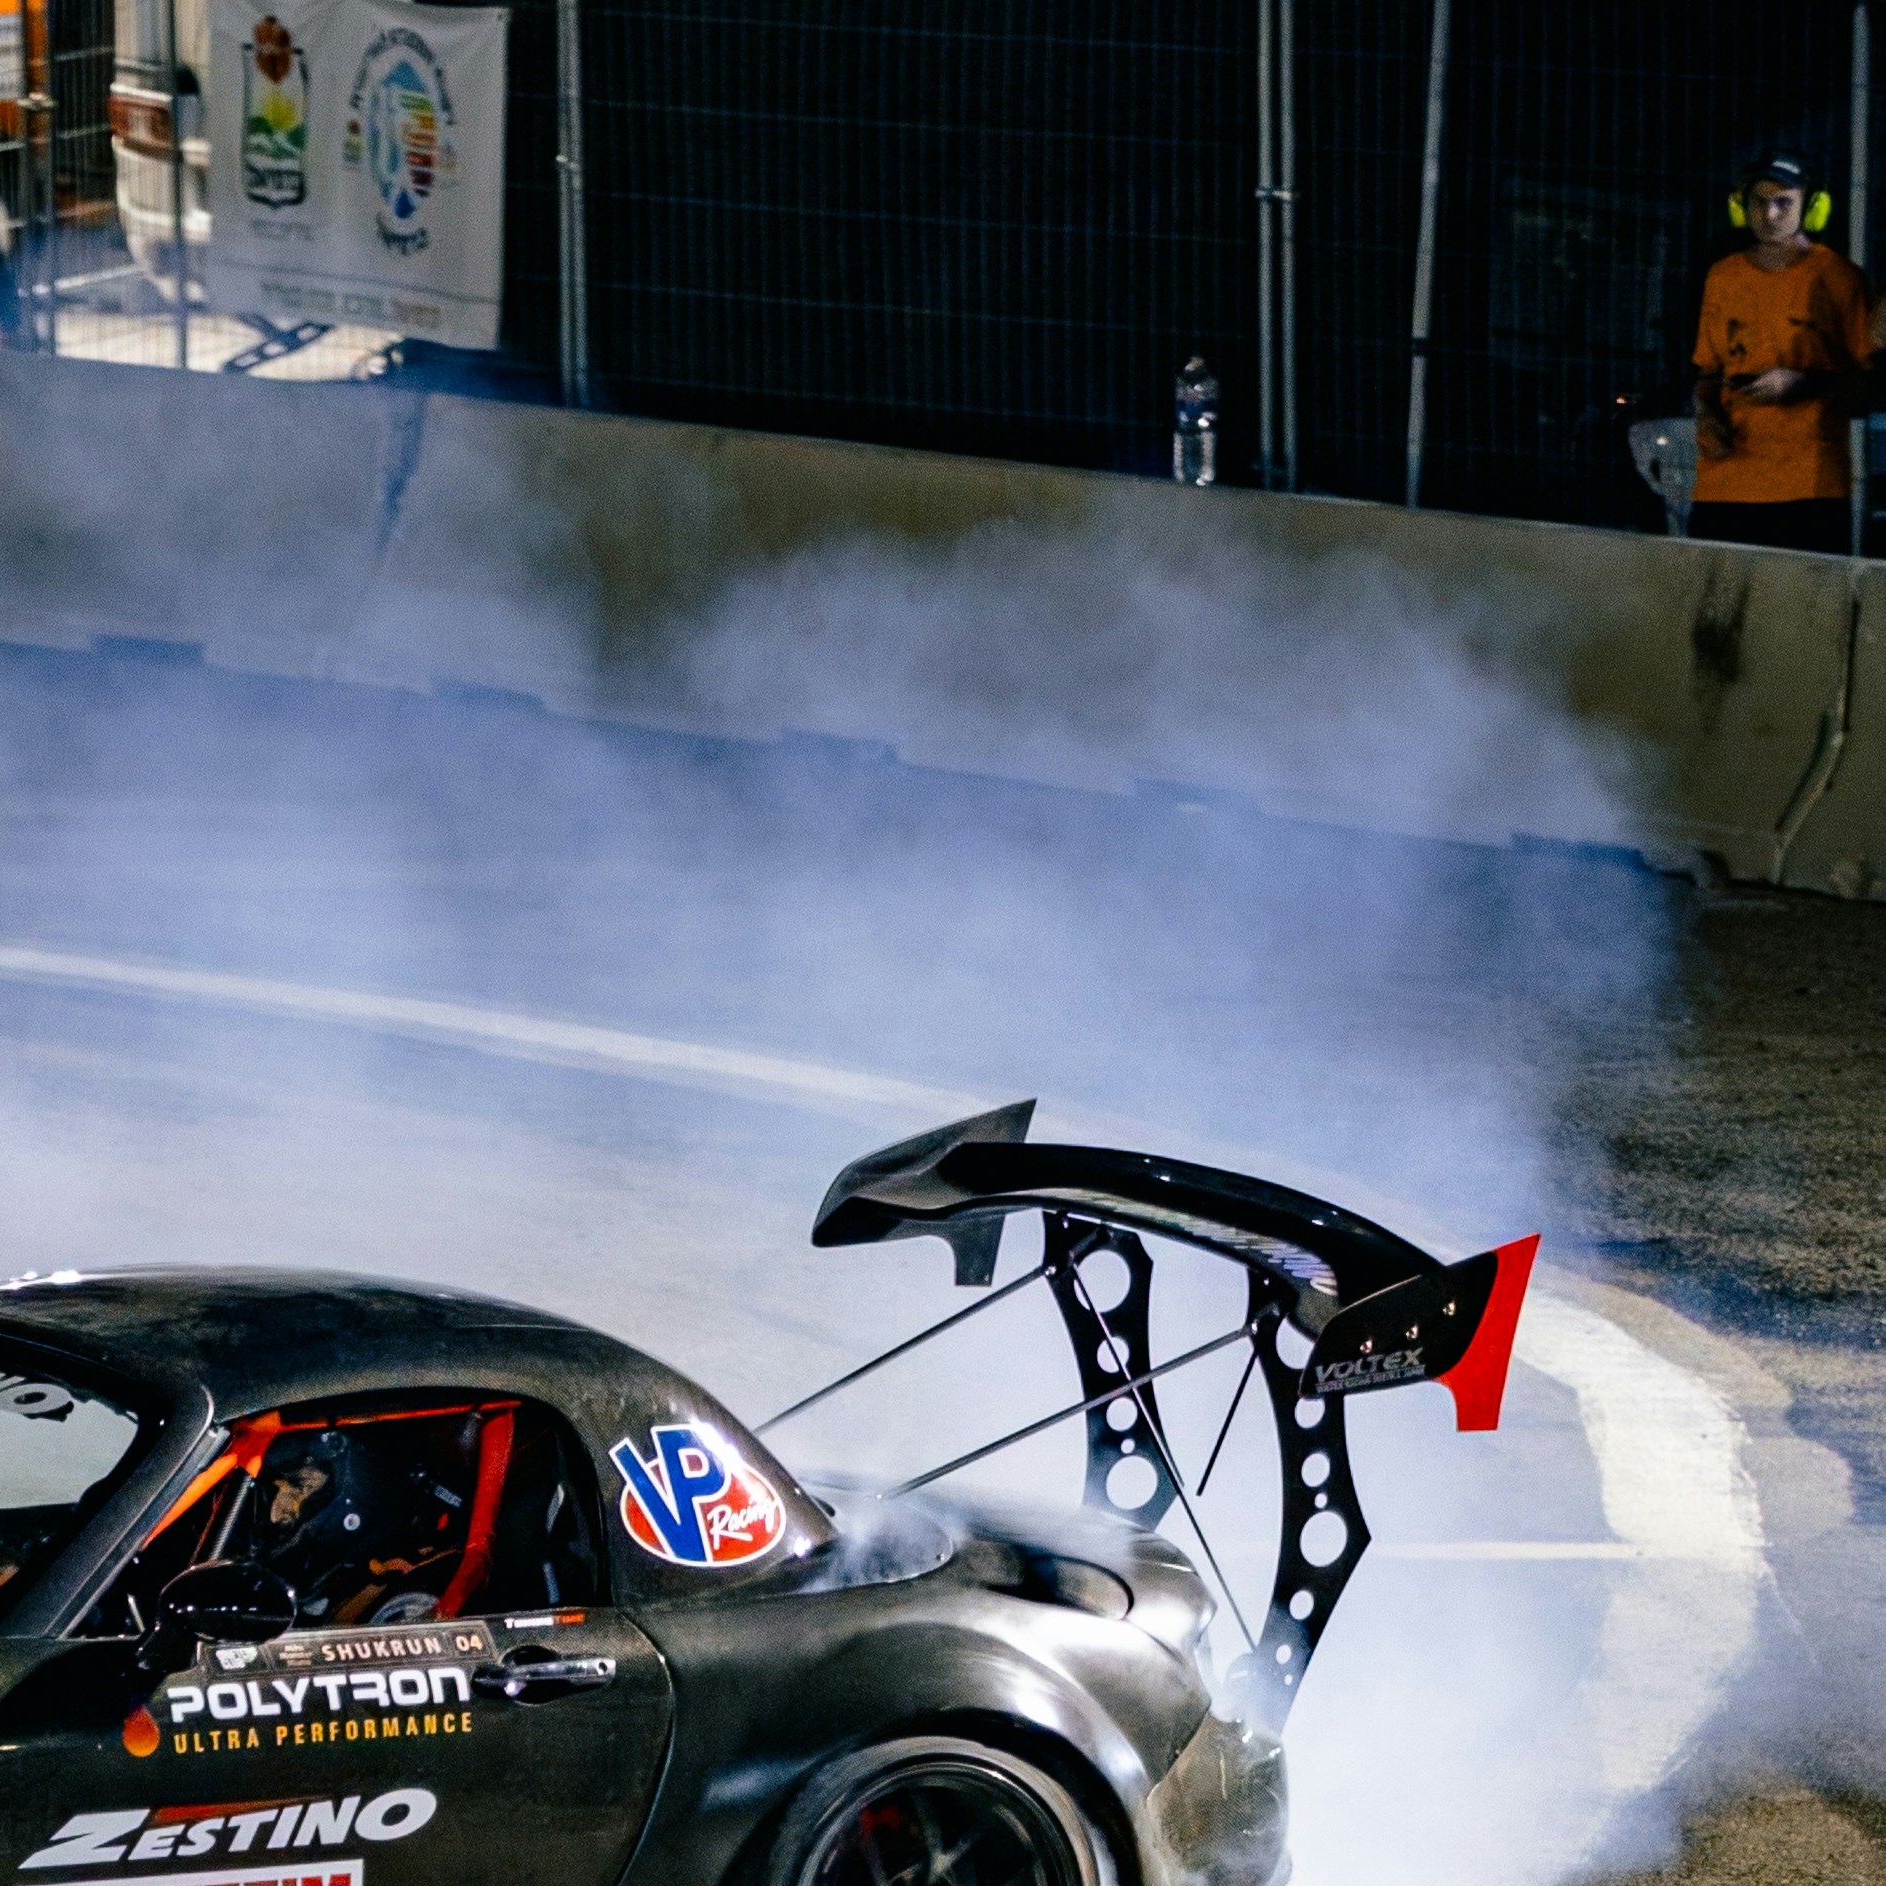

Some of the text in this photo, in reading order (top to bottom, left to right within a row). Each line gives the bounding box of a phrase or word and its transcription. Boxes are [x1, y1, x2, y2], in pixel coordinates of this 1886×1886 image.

[1314, 1346, 1425, 1382] VOLTEX
[610, 1425, 730, 1563] VP
[706, 1500, 778, 1550] Racing
[321, 1636, 443, 1663] SHUKRUN
[454, 1633, 484, 1653] 04
[166, 1667, 471, 1723] POLYTRON
[173, 1711, 474, 1755] ULTRA PERFORMANCE
[17, 1787, 438, 1870] ZESTINO
